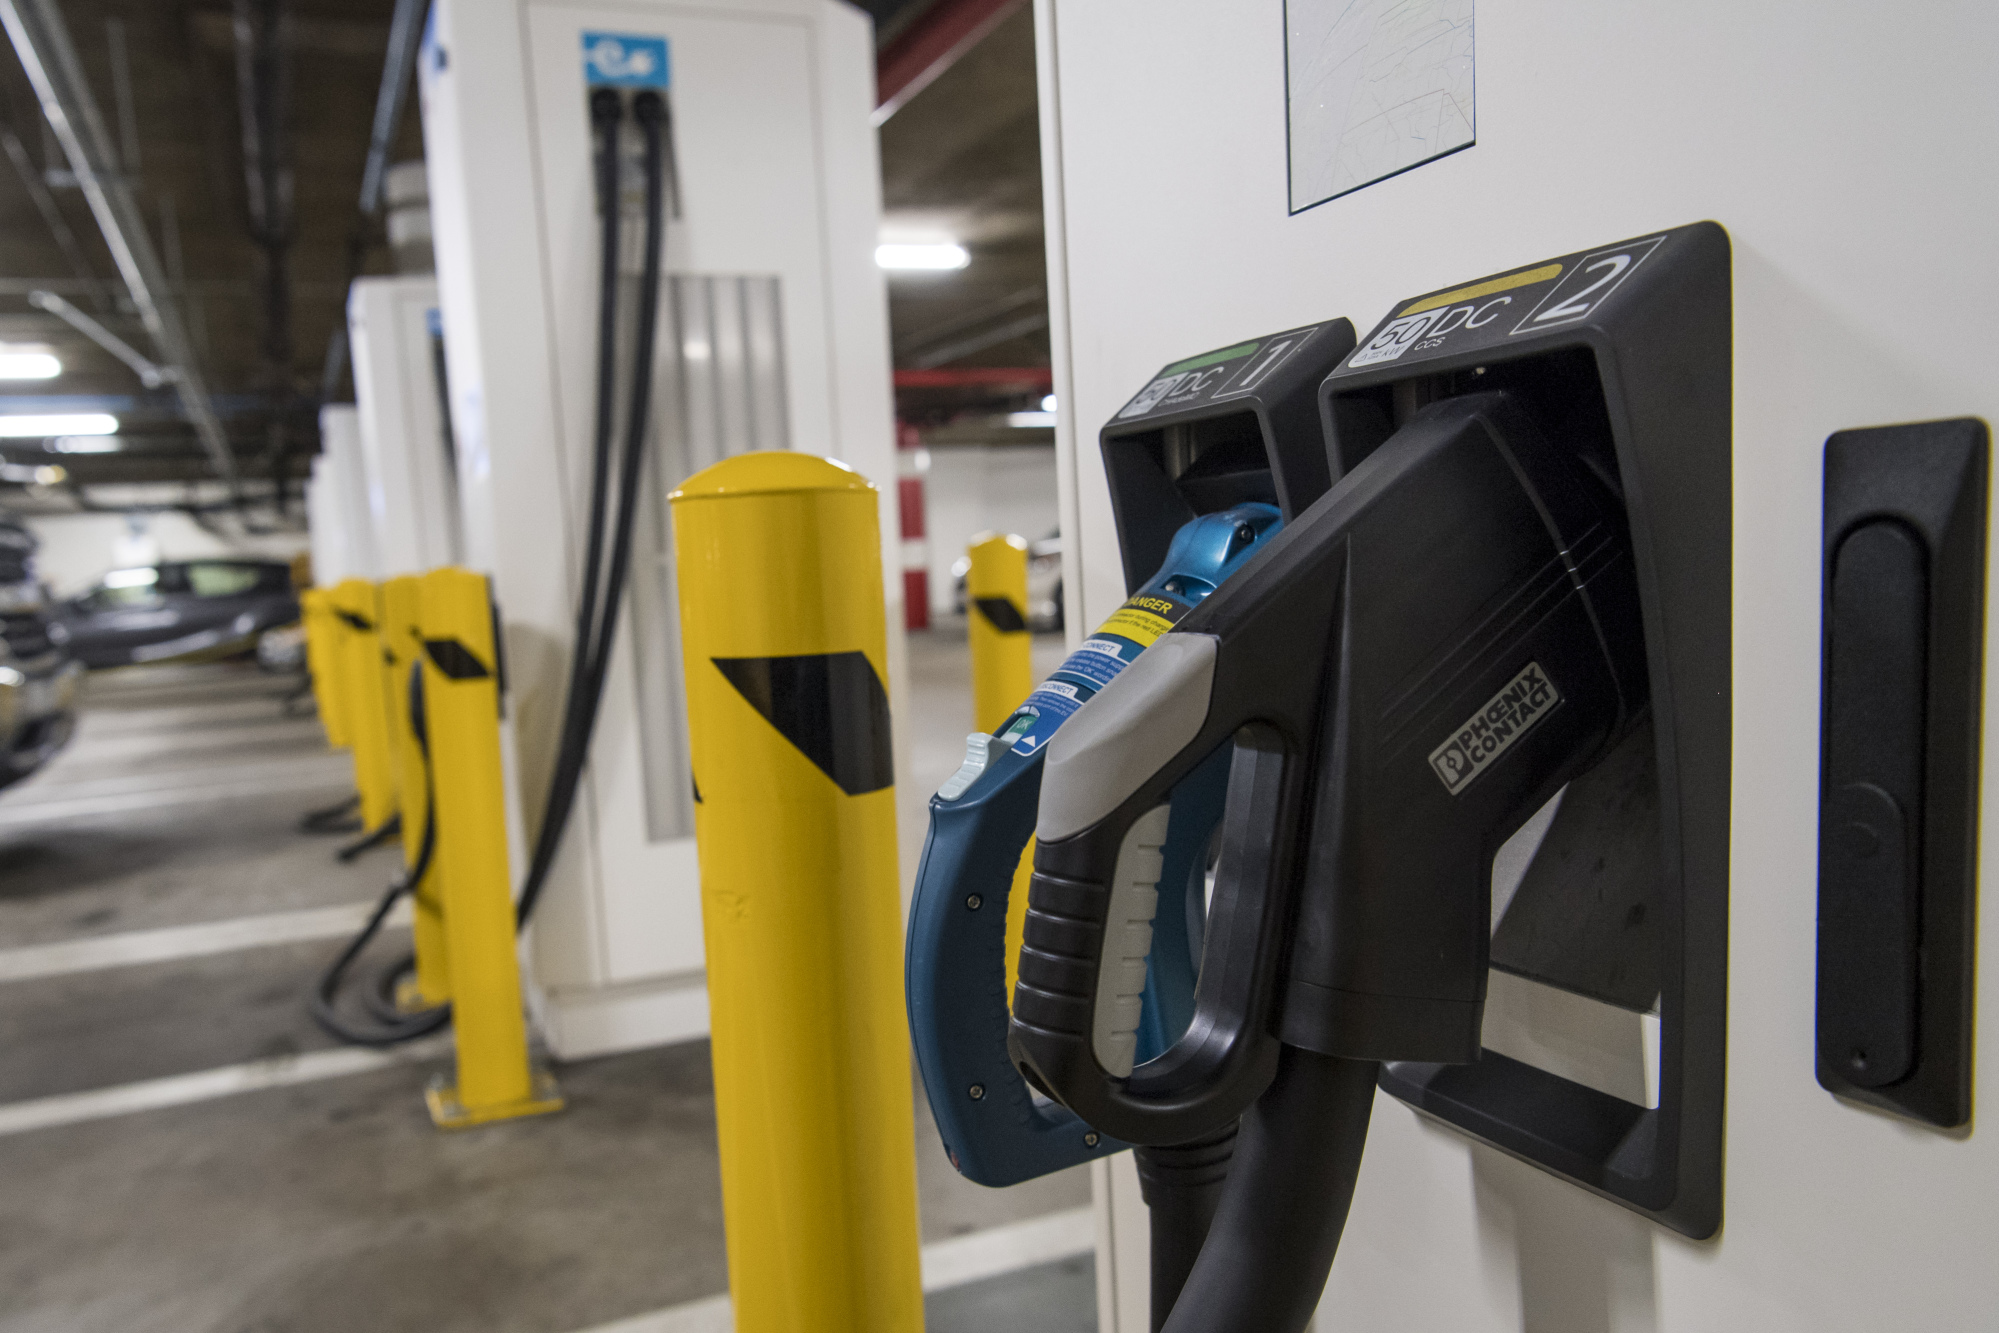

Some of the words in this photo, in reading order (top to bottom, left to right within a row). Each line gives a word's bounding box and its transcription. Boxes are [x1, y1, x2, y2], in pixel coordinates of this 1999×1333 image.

[1533, 254, 1631, 322] 2
[1370, 316, 1431, 350] 50
[1426, 296, 1511, 338] DC
[1414, 337, 1446, 350] CCS
[1168, 366, 1224, 397] DC
[1239, 340, 1292, 386] 1
[1470, 680, 1551, 763] CONTACT
